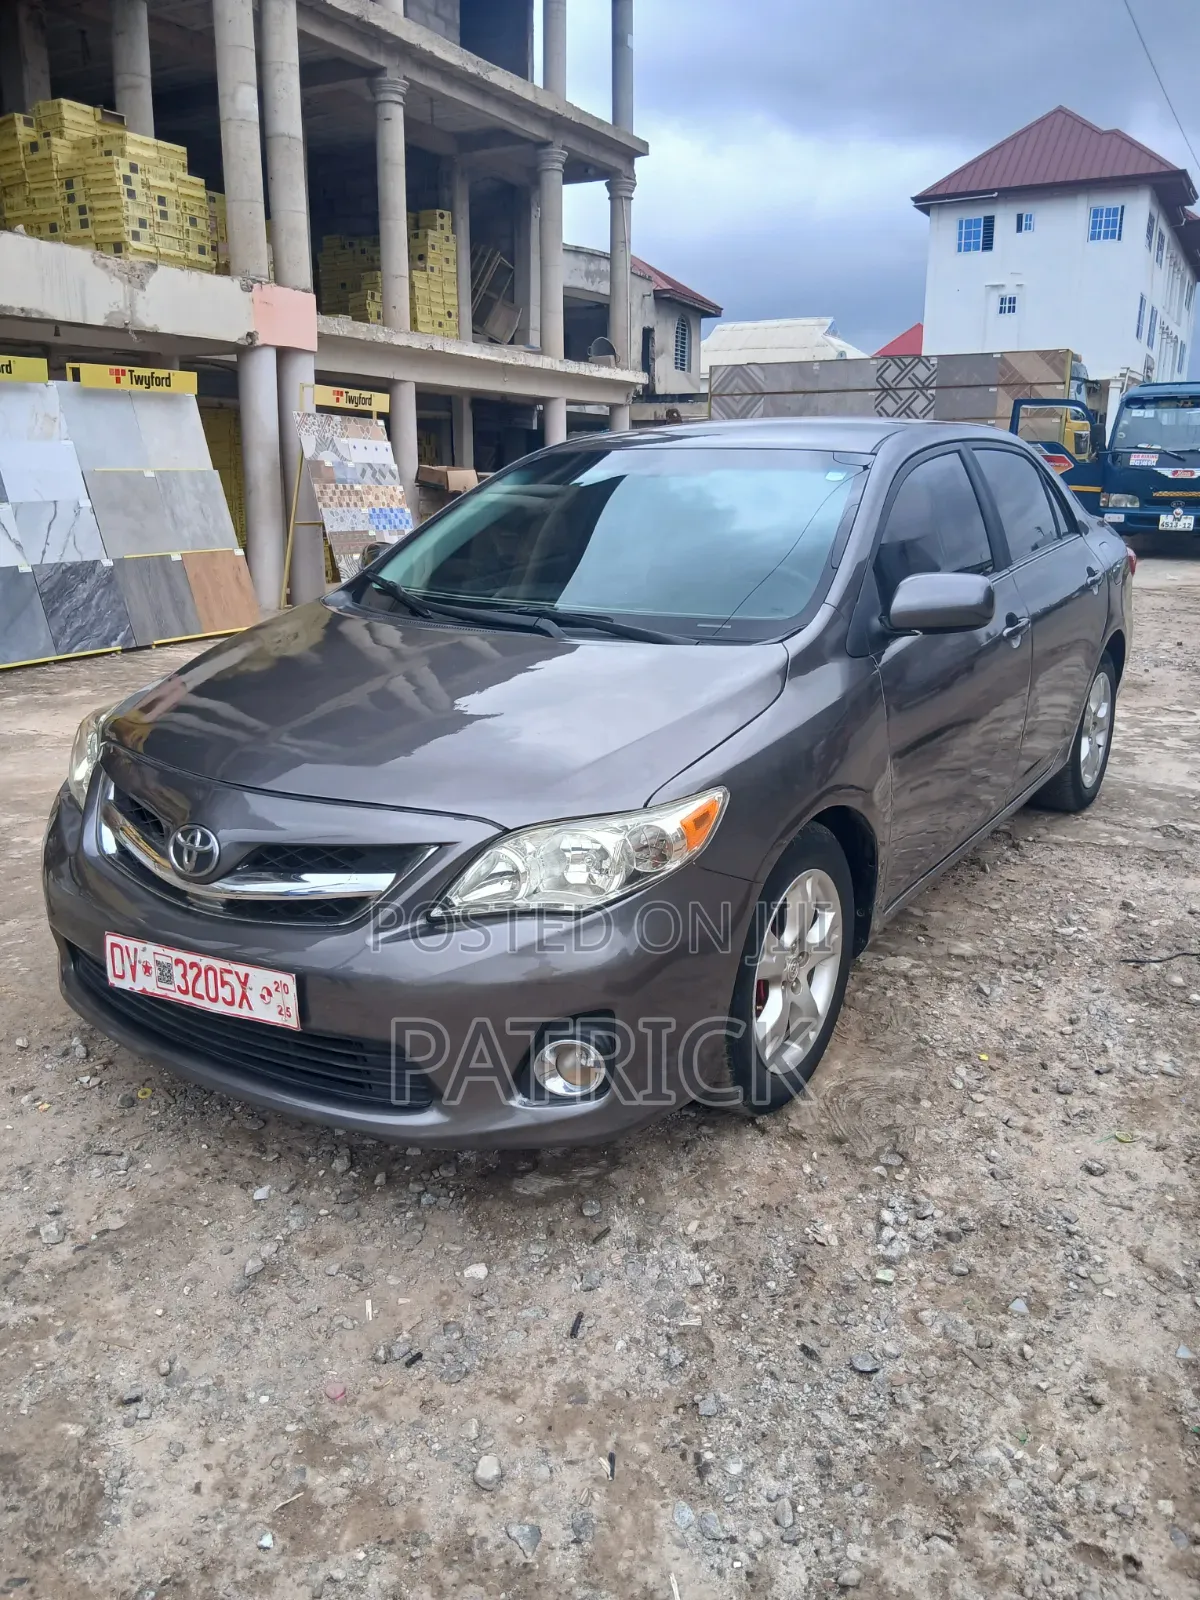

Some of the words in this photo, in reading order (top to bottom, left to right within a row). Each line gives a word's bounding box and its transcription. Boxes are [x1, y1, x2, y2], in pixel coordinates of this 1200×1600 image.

[128, 369, 172, 390] Twyford
[344, 390, 373, 408] Twyford
[110, 941, 138, 983] DV
[173, 957, 254, 1011] 3205X
